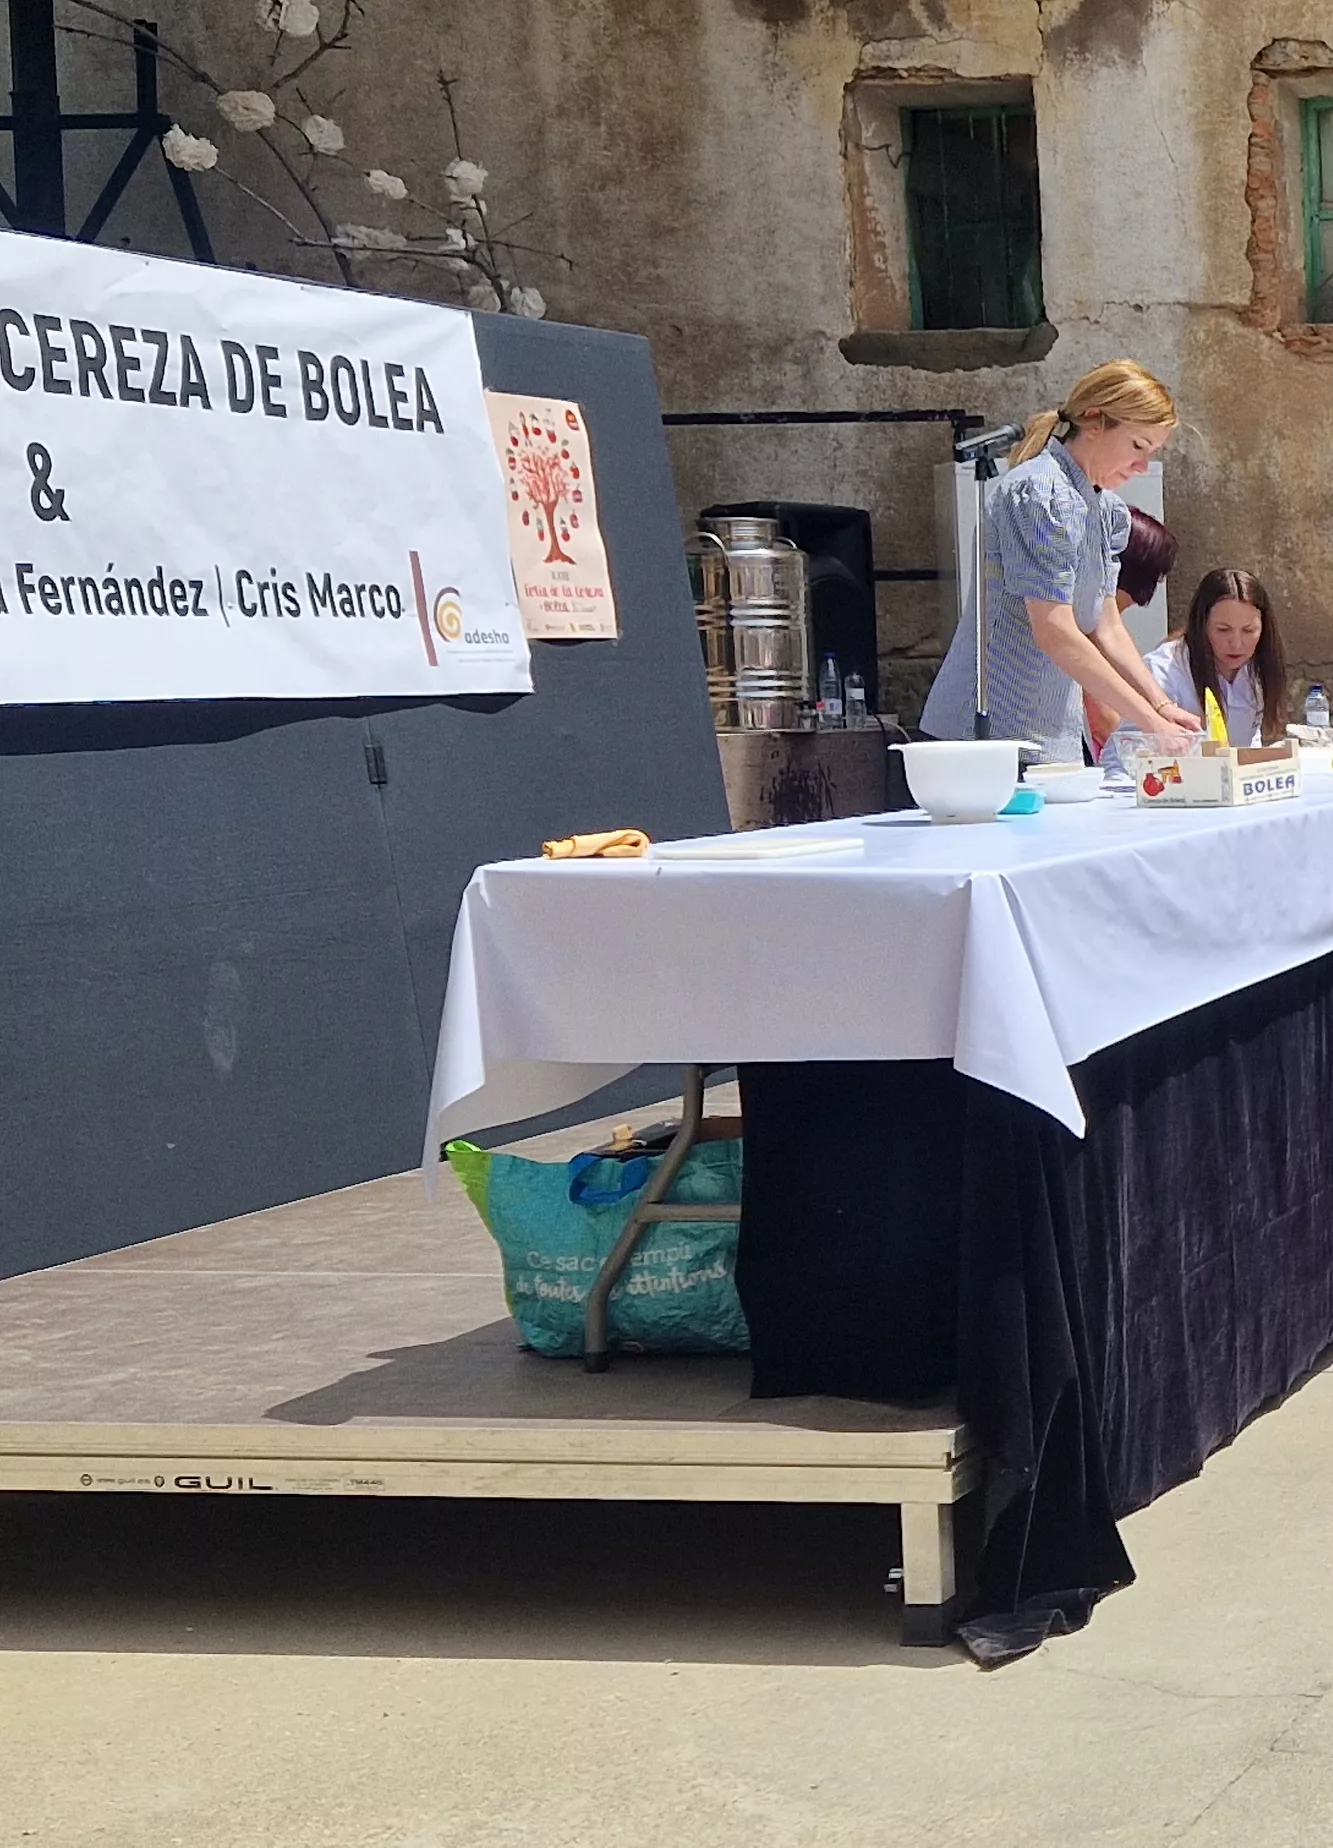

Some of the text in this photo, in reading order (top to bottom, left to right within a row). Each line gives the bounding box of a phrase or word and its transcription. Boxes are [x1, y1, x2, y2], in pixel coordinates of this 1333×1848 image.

[0, 308, 445, 434] CEREZA DE BOLEA
[27, 442, 71, 521] &
[15, 562, 209, 616] Fernández
[236, 567, 301, 617] Cris
[305, 572, 401, 619] Marco
[1243, 774, 1295, 796] BOLEA
[527, 1251, 549, 1268] Ce
[556, 1255, 596, 1272] sac
[534, 1273, 584, 1303] toutes
[174, 1475, 273, 1491] GUIL
